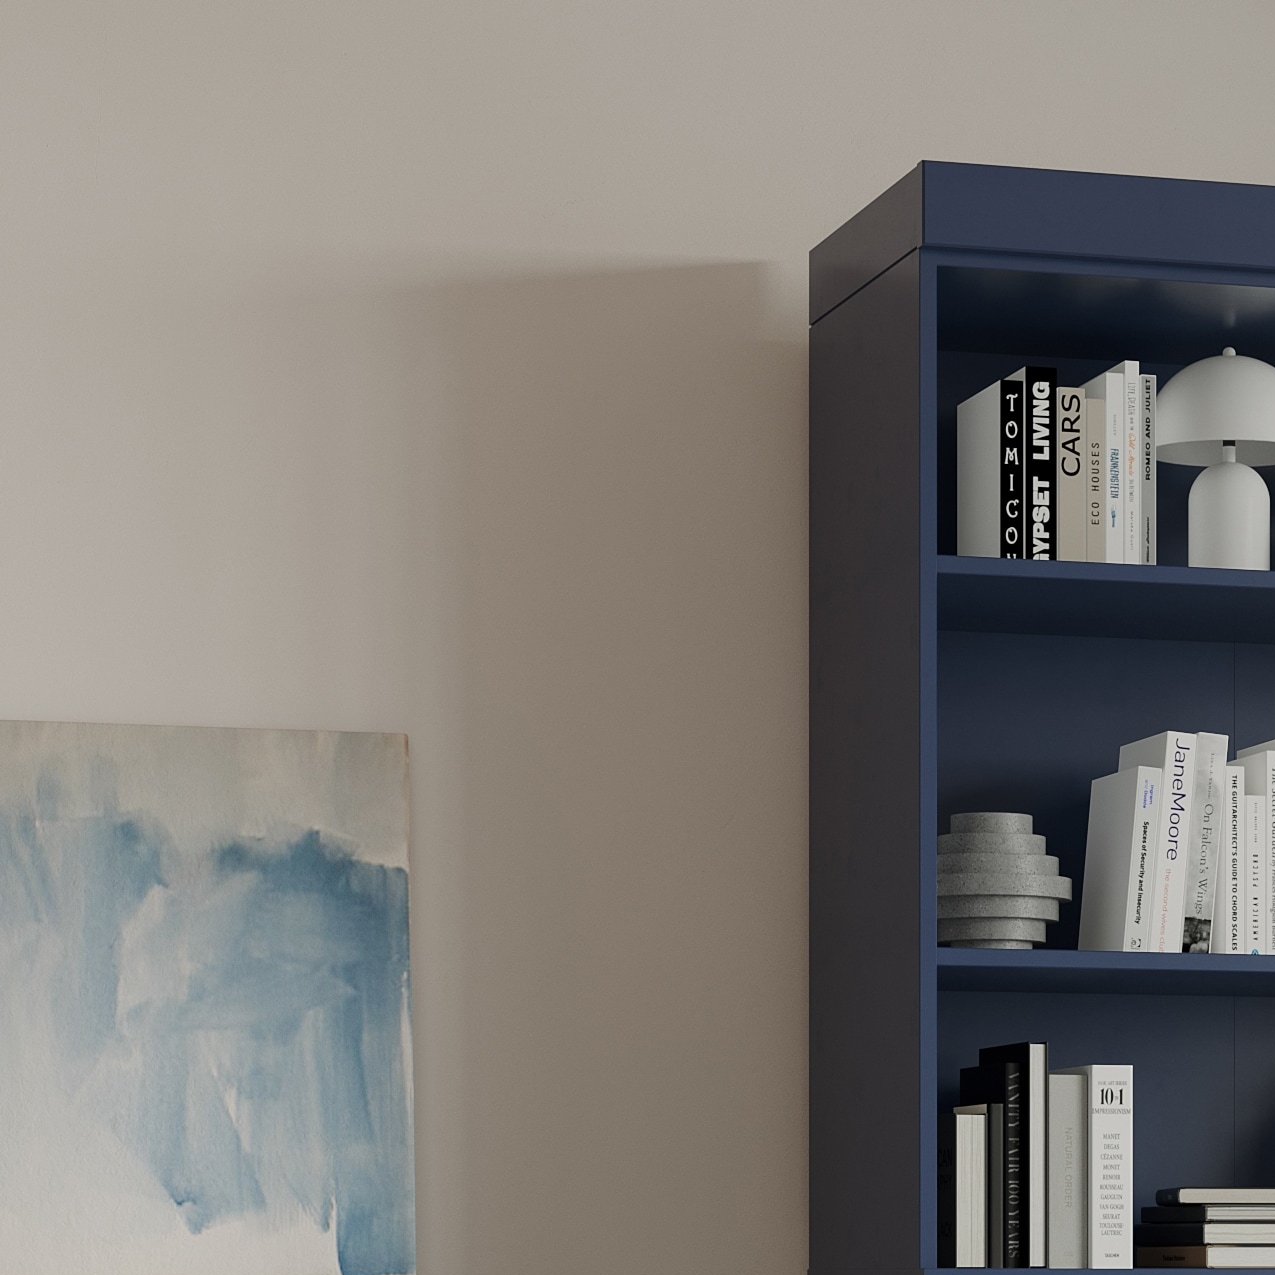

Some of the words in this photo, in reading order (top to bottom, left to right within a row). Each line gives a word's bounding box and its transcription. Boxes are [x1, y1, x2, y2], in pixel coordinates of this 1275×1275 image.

[1032, 381, 1050, 460] LIVING
[1061, 394, 1080, 477] CARS
[1004, 393, 1019, 559] TOMICO
[1091, 442, 1100, 492] HOUSES
[1110, 448, 1119, 499] FRANKENSTEIN
[1091, 501, 1100, 525] ECO
[1203, 803, 1214, 823] On
[1138, 852, 1147, 878] Security
[1199, 827, 1212, 874] Falcon's
[1134, 892, 1143, 925] Insecurity
[1194, 878, 1208, 915] Wings
[1231, 883, 1238, 893] TO
[1008, 1072, 1020, 1127] VANITY
[1008, 1137, 1020, 1173] FAIR
[1064, 1127, 1073, 1173] NATURAL
[1064, 1174, 1073, 1209] ORDER
[1008, 1209, 1020, 1258] YEARS
